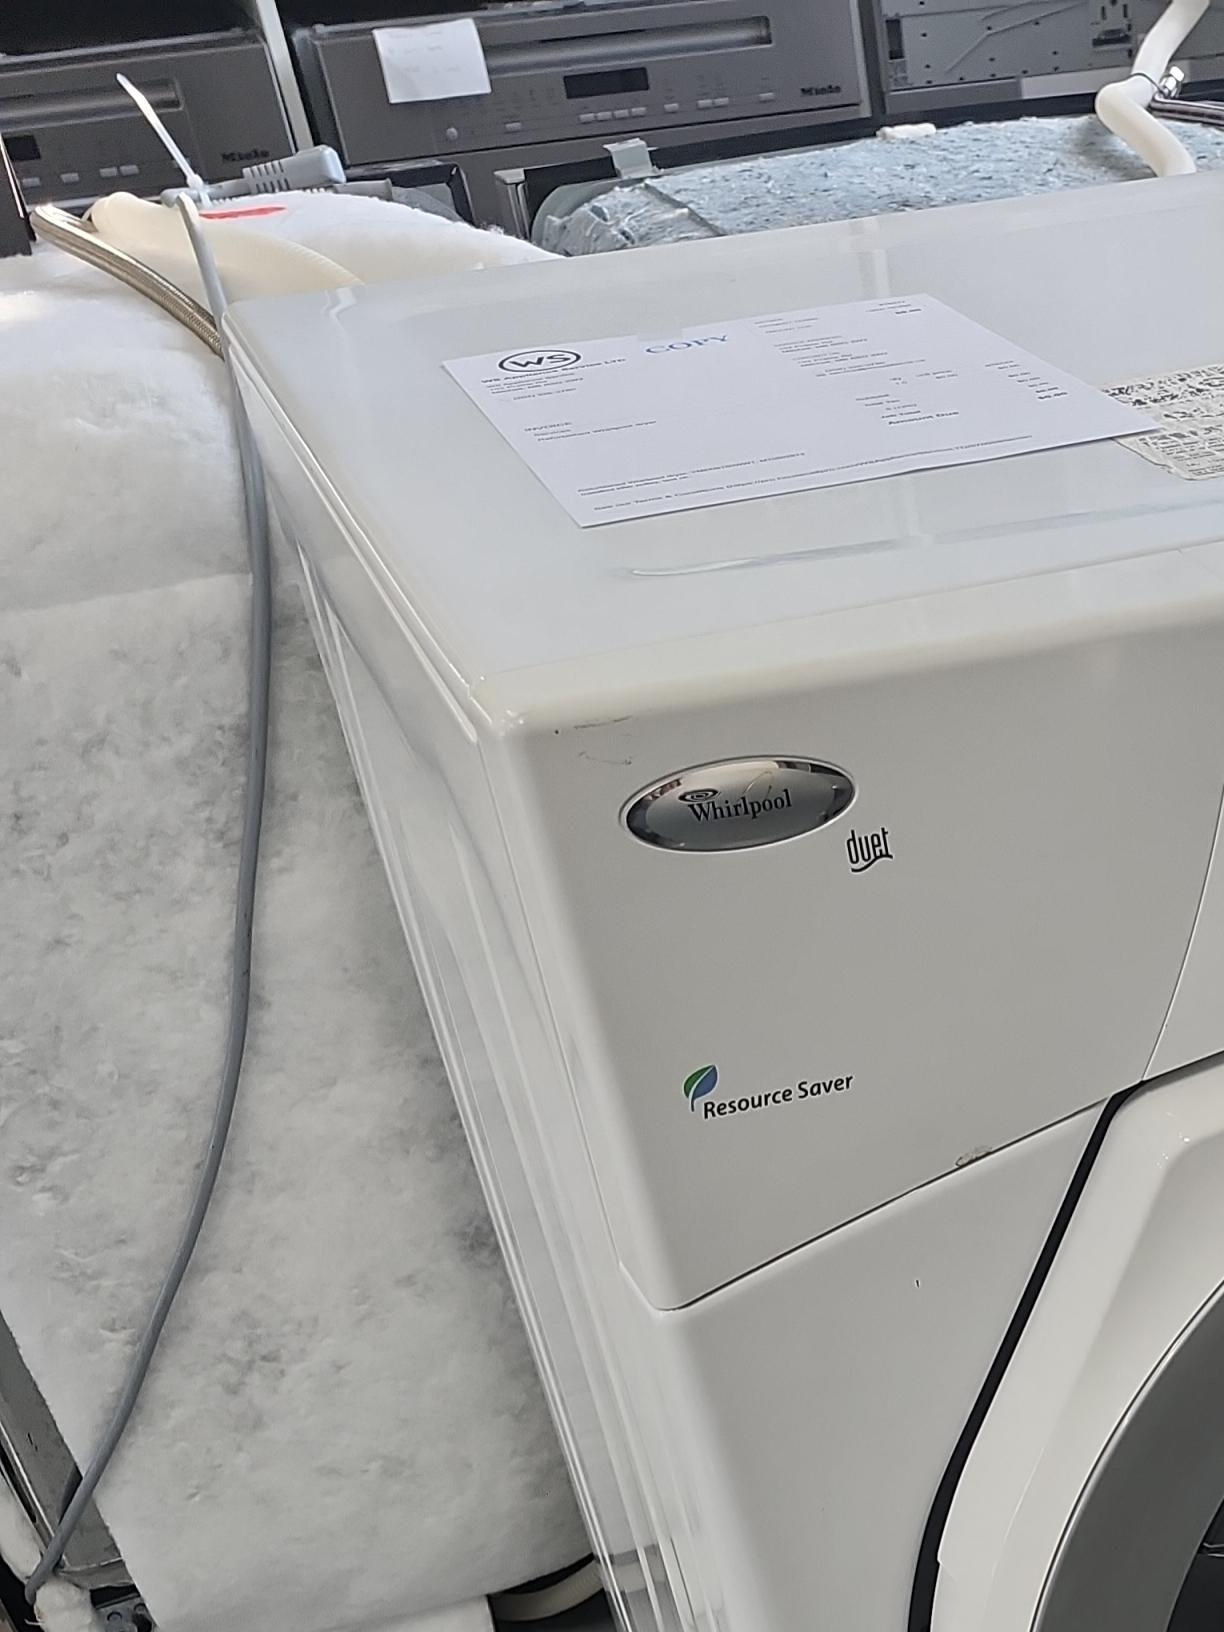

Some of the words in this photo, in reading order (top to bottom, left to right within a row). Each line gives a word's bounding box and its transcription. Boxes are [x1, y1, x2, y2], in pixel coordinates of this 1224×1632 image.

[509, 353, 572, 368] WS
[645, 334, 729, 354] COPY
[687, 788, 793, 824] Whirlpool
[846, 827, 892, 868] duet
[703, 1086, 793, 1119] Resource
[797, 1074, 853, 1100] Saver
